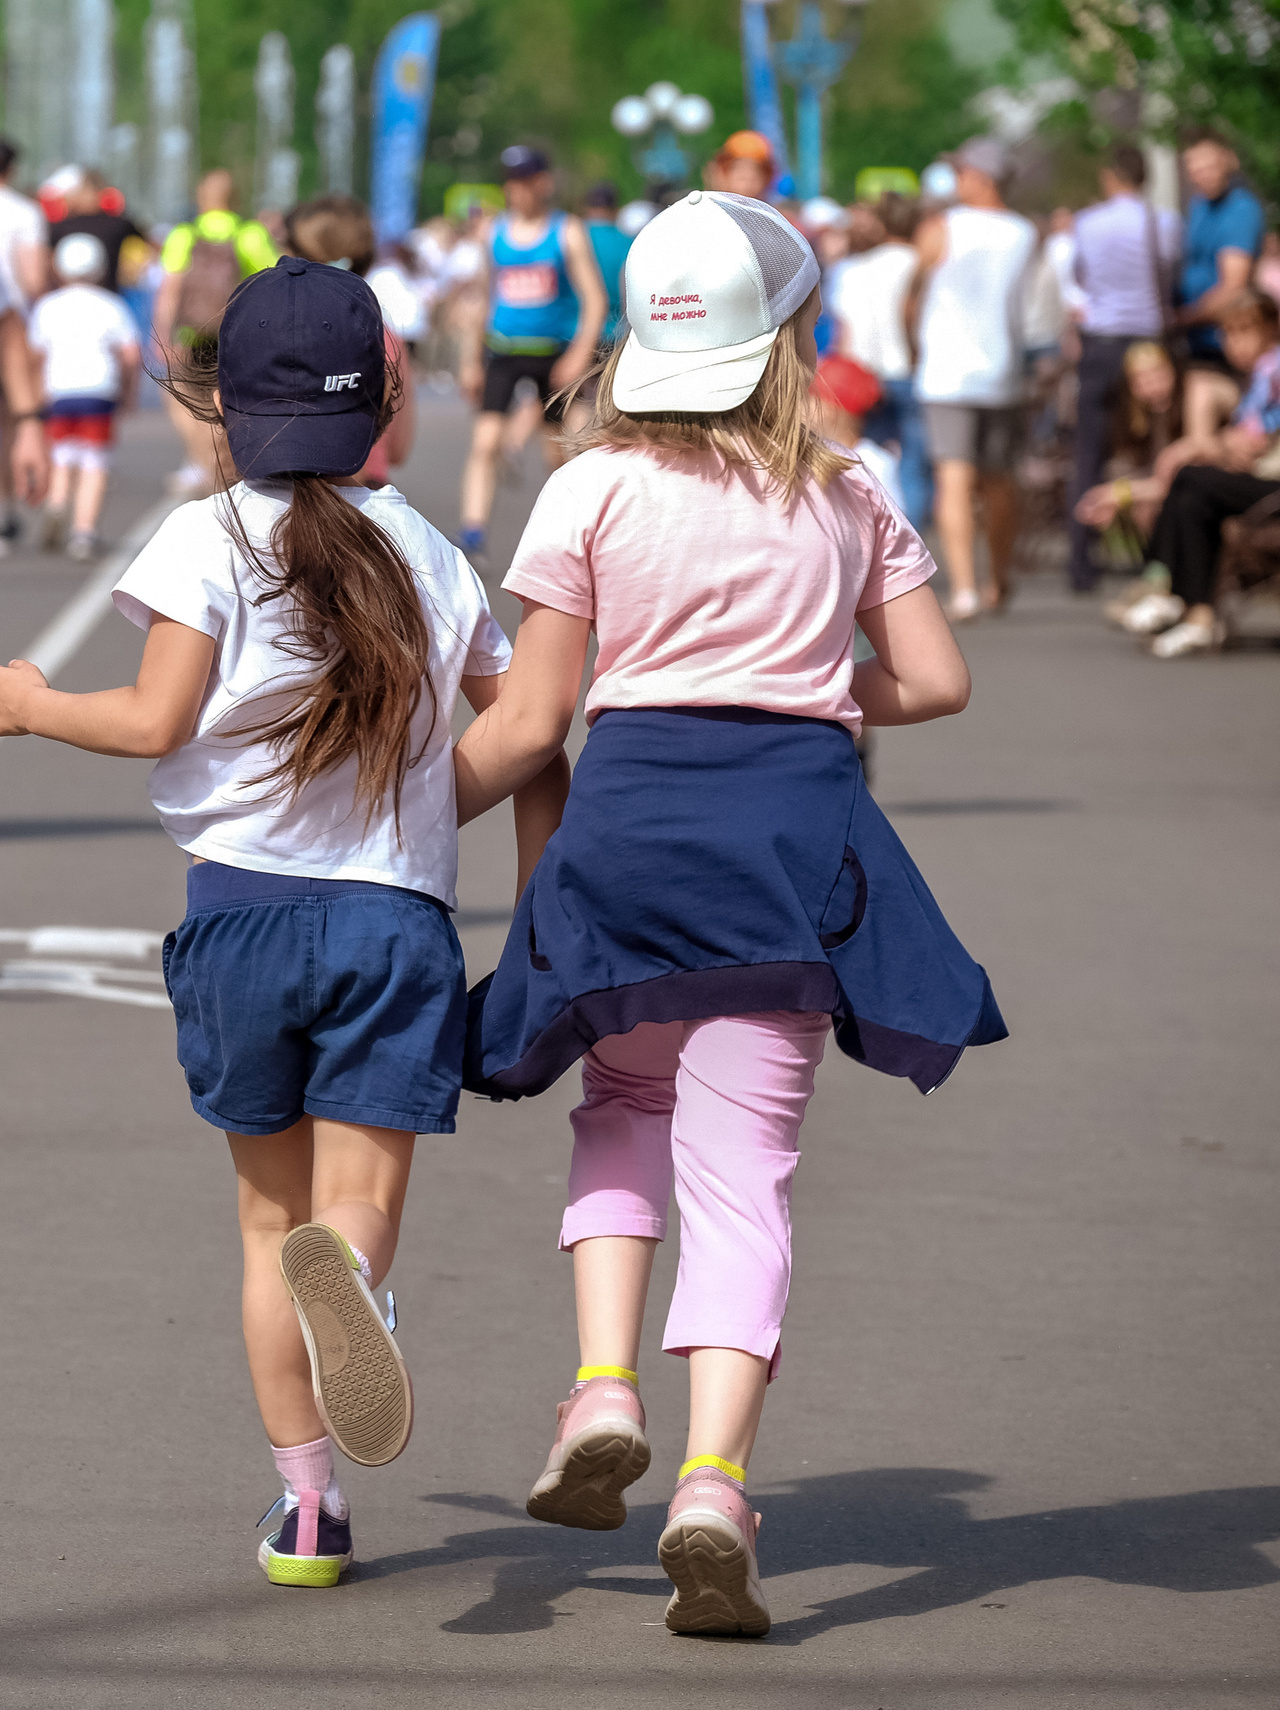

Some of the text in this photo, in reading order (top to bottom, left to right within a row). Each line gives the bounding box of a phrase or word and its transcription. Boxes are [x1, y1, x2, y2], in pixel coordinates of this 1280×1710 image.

[650, 294, 702, 306] Я девочка,
[650, 310, 707, 321] мне можно
[324, 372, 362, 392] UFC
